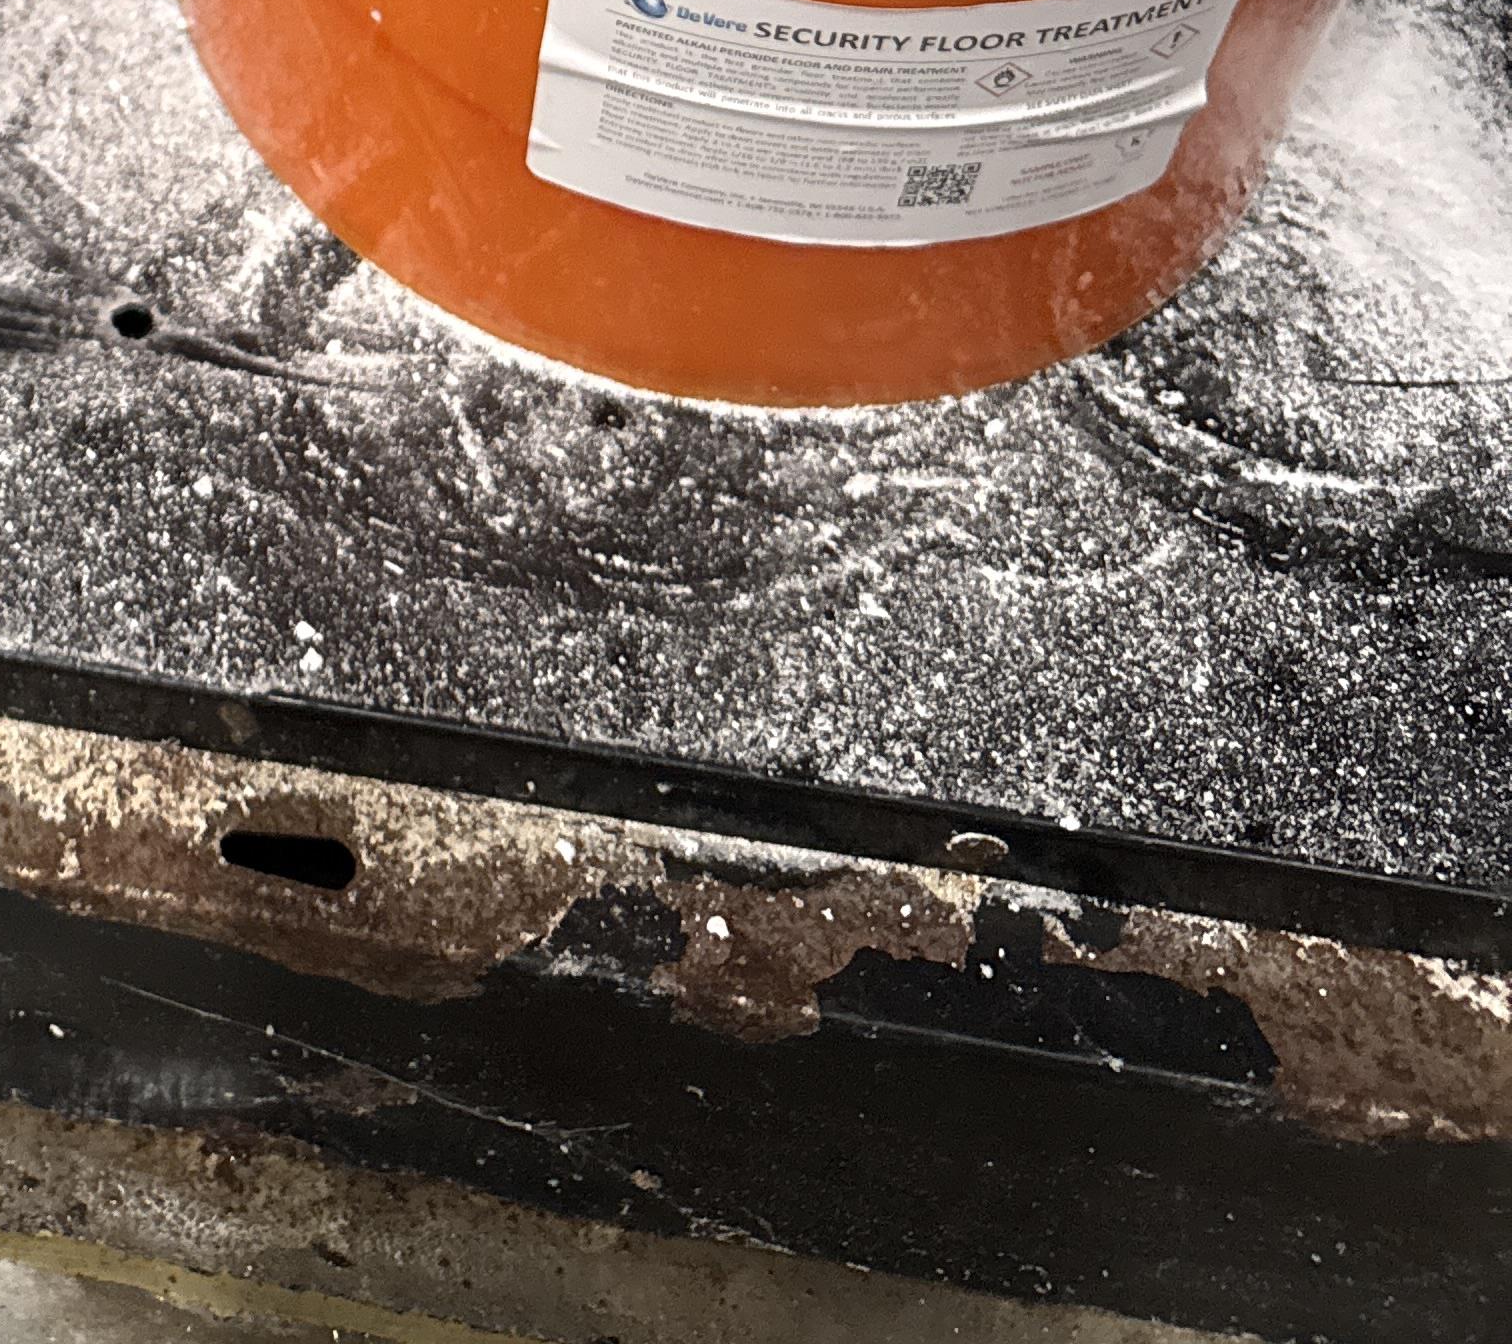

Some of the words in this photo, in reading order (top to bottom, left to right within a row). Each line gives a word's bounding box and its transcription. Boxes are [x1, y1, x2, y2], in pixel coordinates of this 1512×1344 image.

[615, 18, 675, 42] PATENTED
[676, 36, 718, 53] ALKALI
[719, 45, 780, 64] PEROXIDE
[781, 55, 822, 70] FLOOR
[823, 62, 852, 72] AND
[853, 64, 893, 75] DRAIN
[896, 65, 968, 76] TREATMENT
[676, 5, 748, 33] DeVere
[753, 21, 912, 52] SECURITY
[918, 30, 1027, 53] FLOOR
[605, 82, 674, 109] DIRECTIONS
